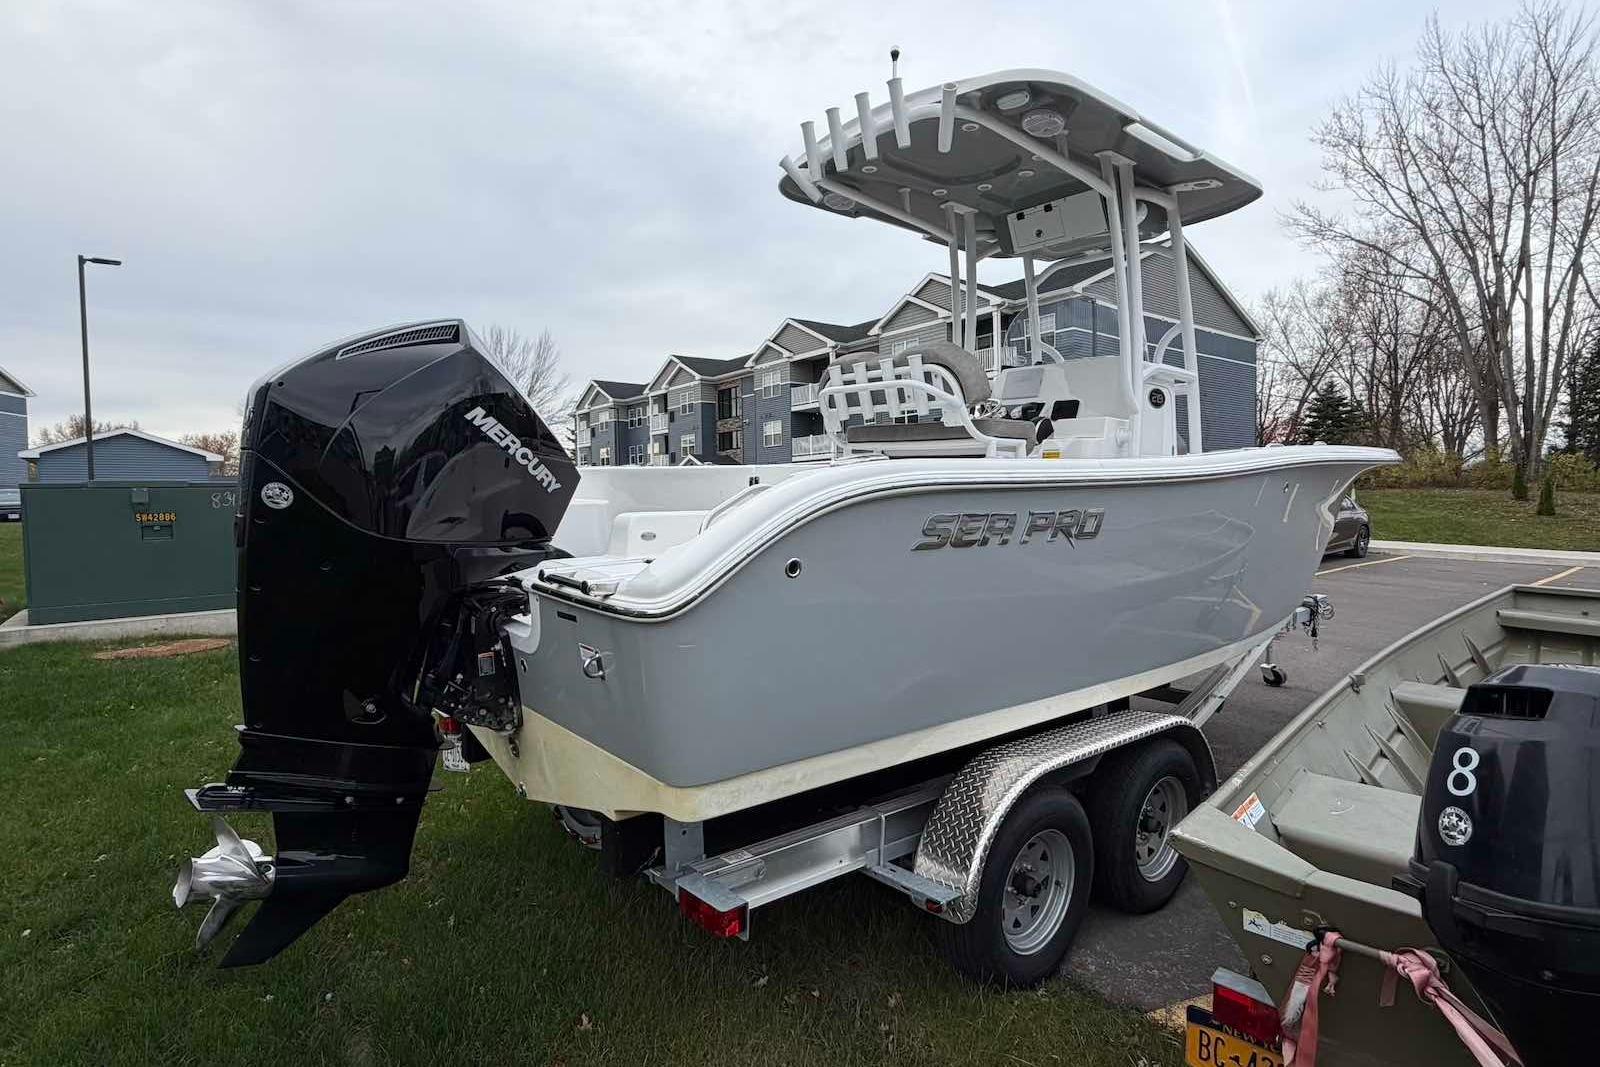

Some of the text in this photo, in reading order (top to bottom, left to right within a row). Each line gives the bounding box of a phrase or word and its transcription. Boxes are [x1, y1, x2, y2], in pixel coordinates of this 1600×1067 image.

[464, 406, 562, 494] MERCURY
[910, 508, 1104, 551] SEA PRO
[1447, 747, 1480, 797] 8
